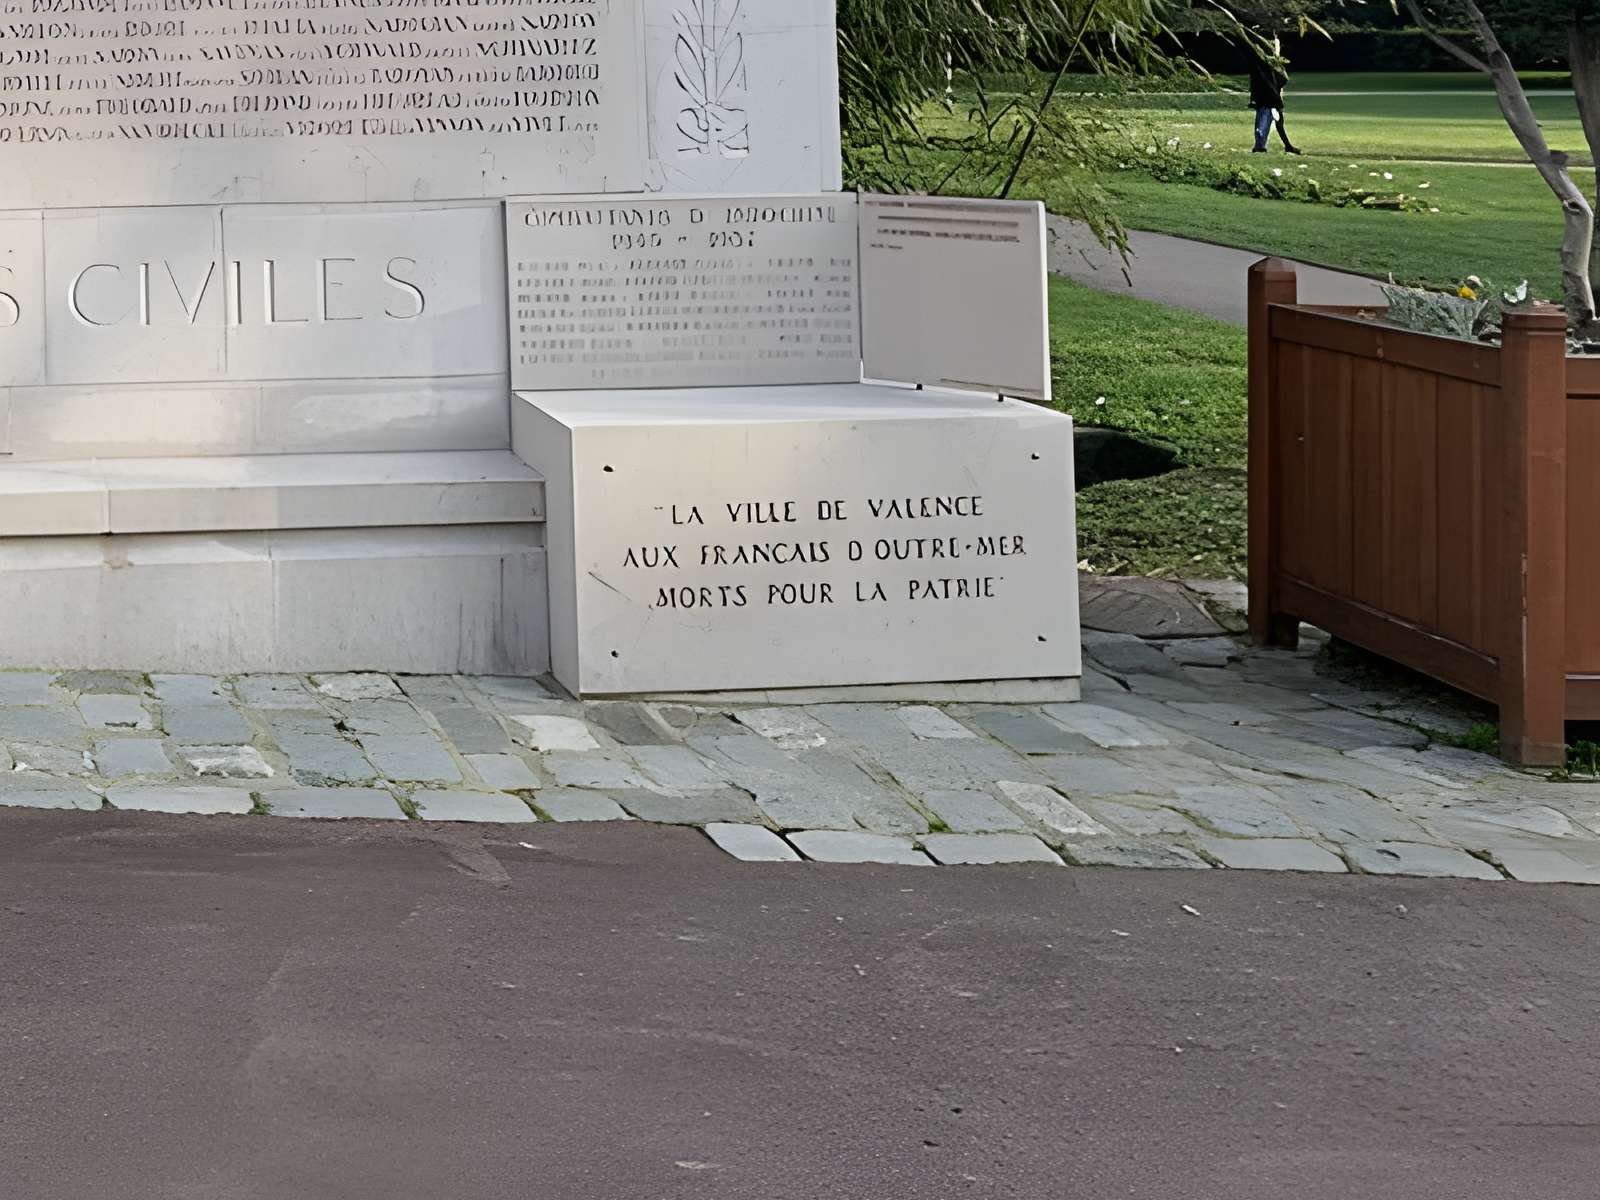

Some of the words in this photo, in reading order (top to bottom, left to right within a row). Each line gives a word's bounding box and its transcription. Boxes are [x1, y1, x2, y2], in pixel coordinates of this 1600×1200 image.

[66, 255, 426, 327] CIVILES
[726, 500, 797, 524] VILLE
[817, 500, 848, 521] DE
[866, 495, 984, 519] VALENCE
[622, 544, 681, 569] AUX
[655, 584, 748, 609] MORTS
[766, 582, 834, 605] POUR
[855, 580, 888, 602] LA
